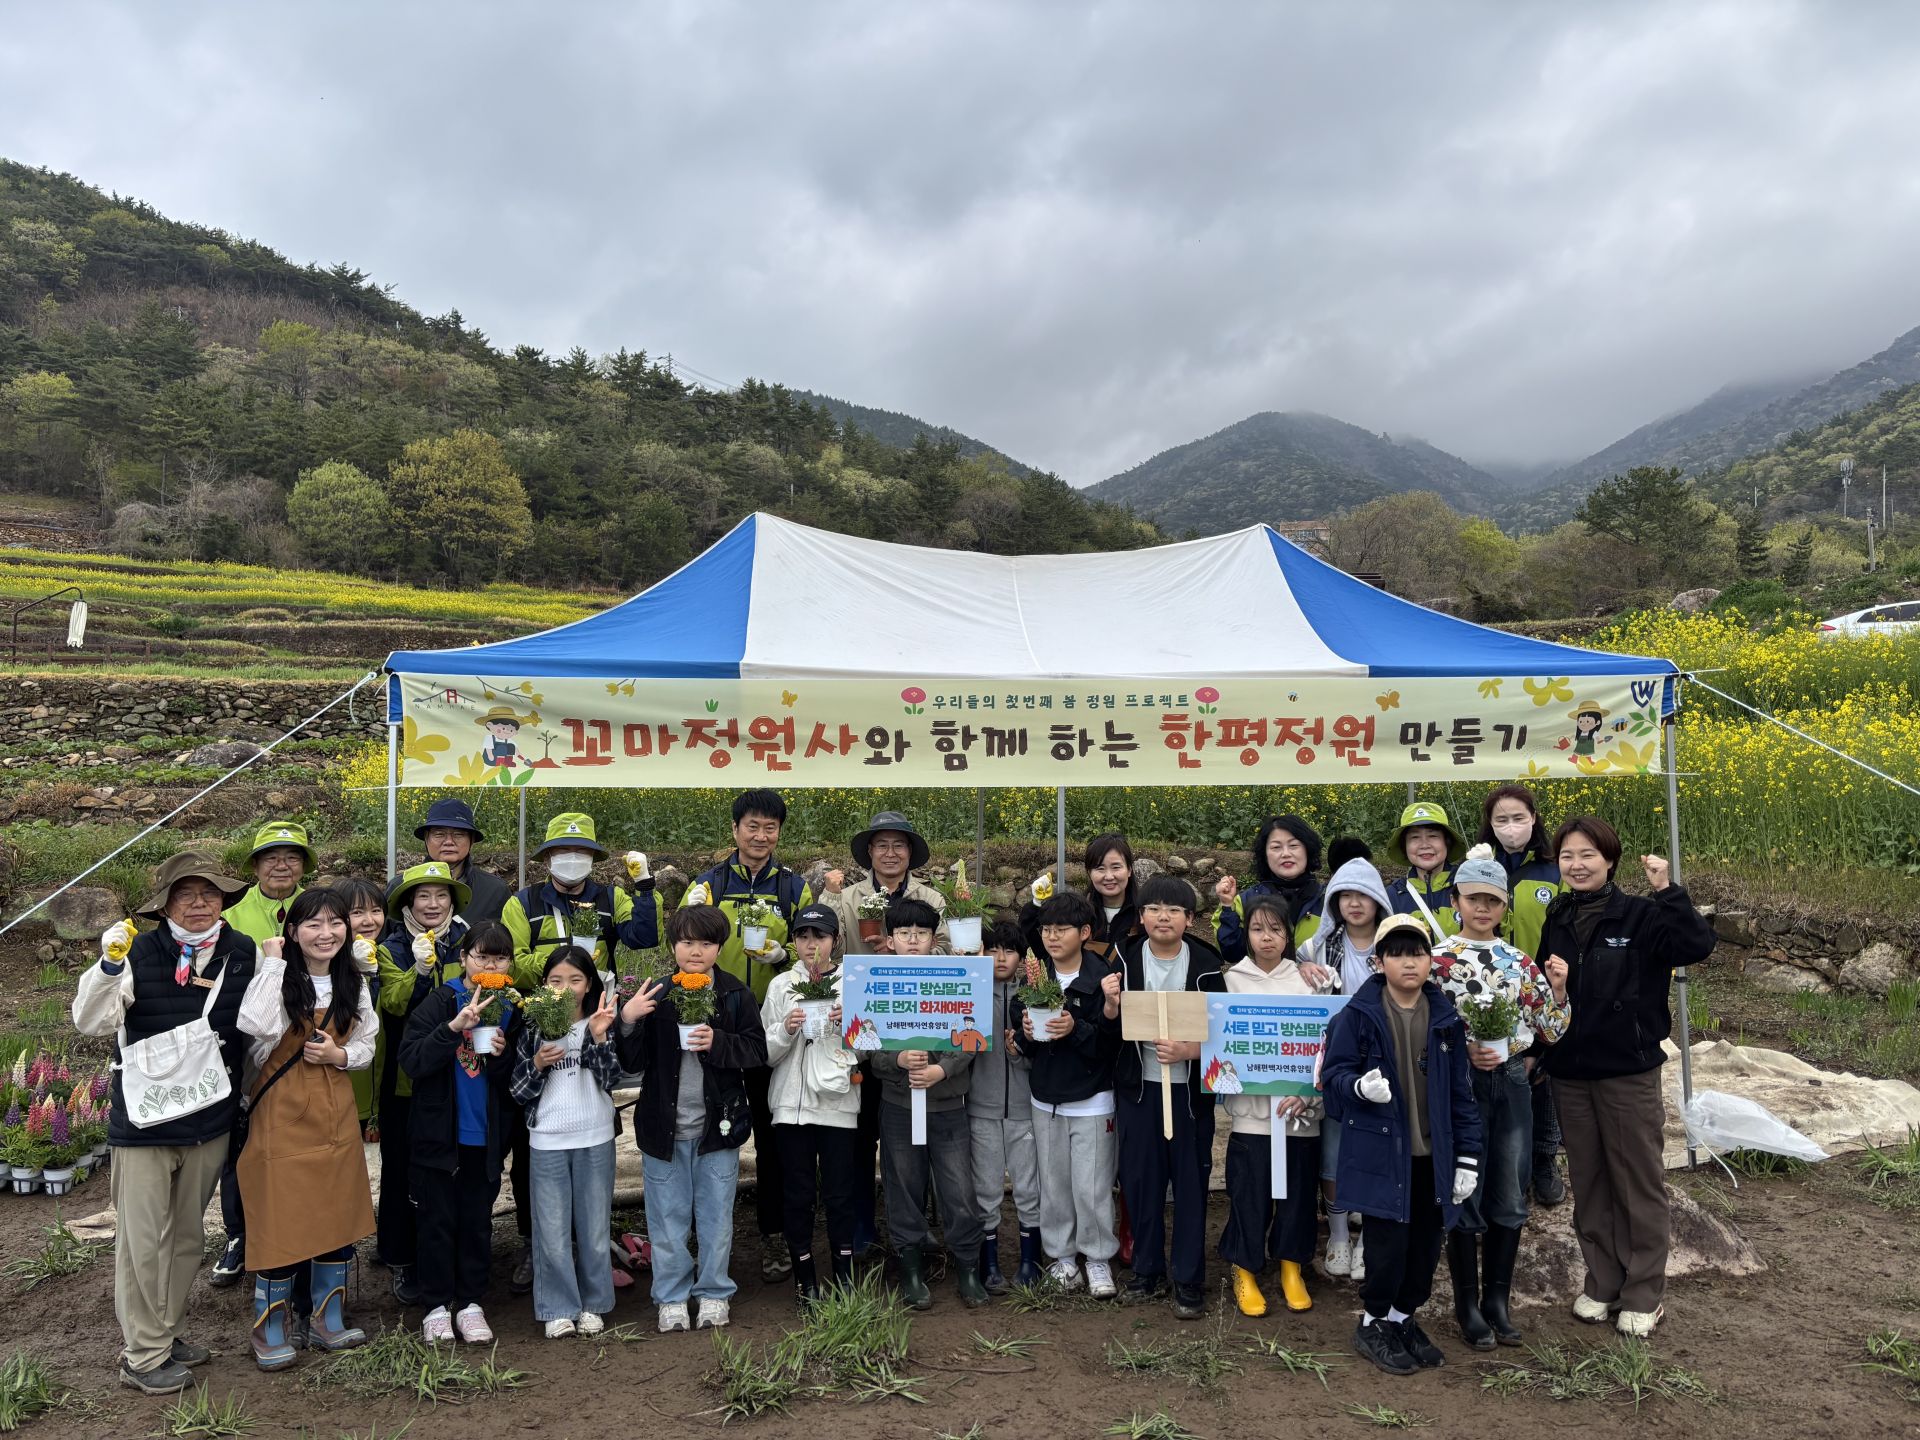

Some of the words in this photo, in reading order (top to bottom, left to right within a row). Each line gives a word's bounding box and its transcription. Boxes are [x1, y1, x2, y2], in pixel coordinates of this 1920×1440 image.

[414, 703, 475, 711] NAMHAE
[932, 695, 995, 709] 우리들의
[1005, 694, 1053, 709] 첫번째
[1062, 694, 1077, 709] 봄
[1086, 694, 1116, 709] 정원
[1124, 694, 1190, 709] 프로젝트
[560, 716, 912, 772] 꼬마정원사와
[930, 720, 1028, 771] 함께
[1048, 719, 1141, 769] 하는
[1158, 713, 1376, 769] 한평정원
[1400, 717, 1528, 765] 만들기
[864, 981, 890, 995] 서로
[892, 982, 918, 995] 믿고
[919, 982, 972, 996] 방심말고
[864, 1000, 890, 1014] 서로
[892, 1000, 918, 1014] 먼저
[919, 1000, 974, 1015] 화재예방
[886, 1021, 949, 1030] 남해편백자연휴양림
[1223, 1020, 1250, 1035] 서로
[1252, 1021, 1279, 1036] 믿고
[1223, 1040, 1250, 1055] 서로
[1252, 1041, 1279, 1056] 먼저
[1246, 1064, 1312, 1074] 남해편백자연휴양림
